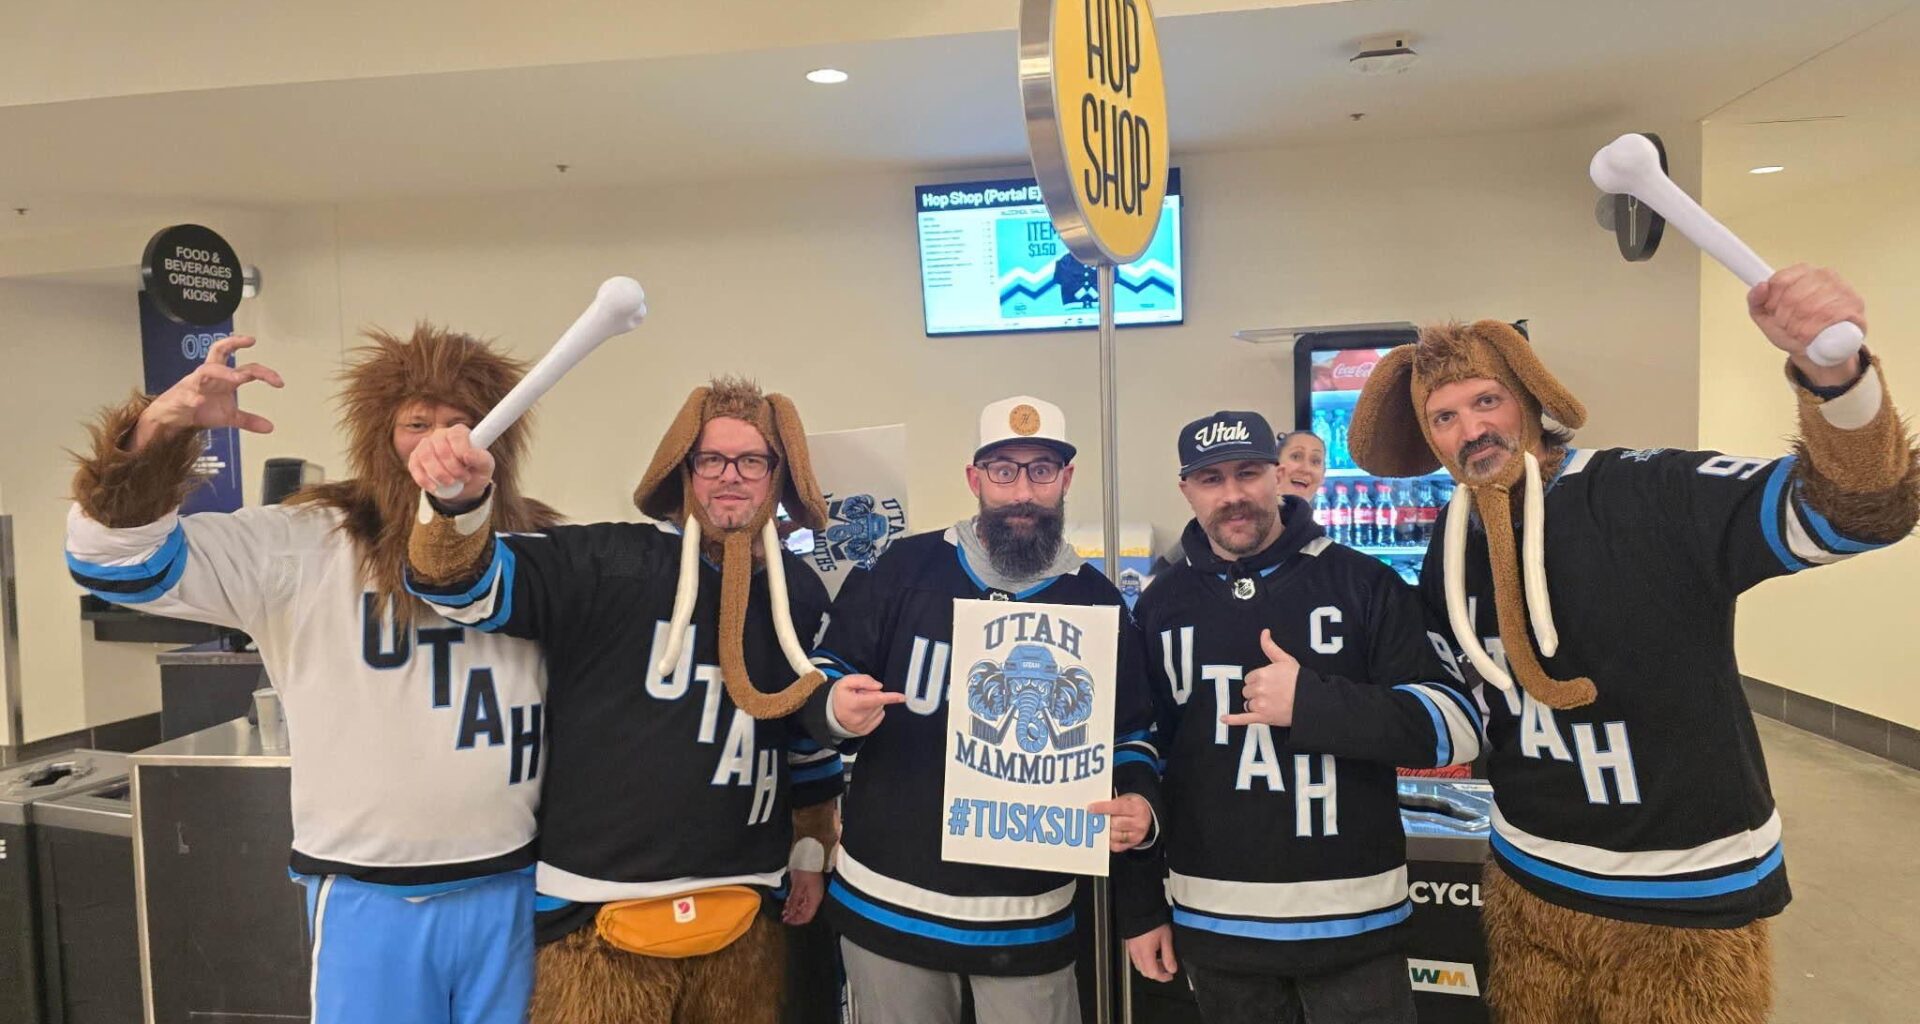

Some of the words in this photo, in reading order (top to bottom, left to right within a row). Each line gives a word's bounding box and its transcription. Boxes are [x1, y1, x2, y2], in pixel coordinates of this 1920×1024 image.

[1085, 0, 1140, 98] HOP
[1082, 93, 1151, 216] SHOP
[922, 193, 949, 208] Hop
[950, 191, 983, 206] Shop
[984, 187, 1027, 204] (Portal
[164, 258, 232, 279] BEVERAGES
[175, 246, 210, 262] FOOD
[211, 252, 220, 263] &
[1028, 243, 1056, 257] $150
[169, 272, 229, 291] ORDERING
[182, 288, 218, 303] KIOSK
[1195, 420, 1250, 448] Utah
[881, 498, 905, 541] UTA
[984, 611, 1083, 660] UTAH
[1310, 606, 1344, 655] C
[362, 592, 542, 785] UTAH
[645, 620, 778, 826] UTAH
[1160, 625, 1339, 837] UTAH
[955, 731, 1106, 785] MAMMOTHS
[947, 797, 1106, 848] #TUSKSUP
[1411, 967, 1467, 988] WM
